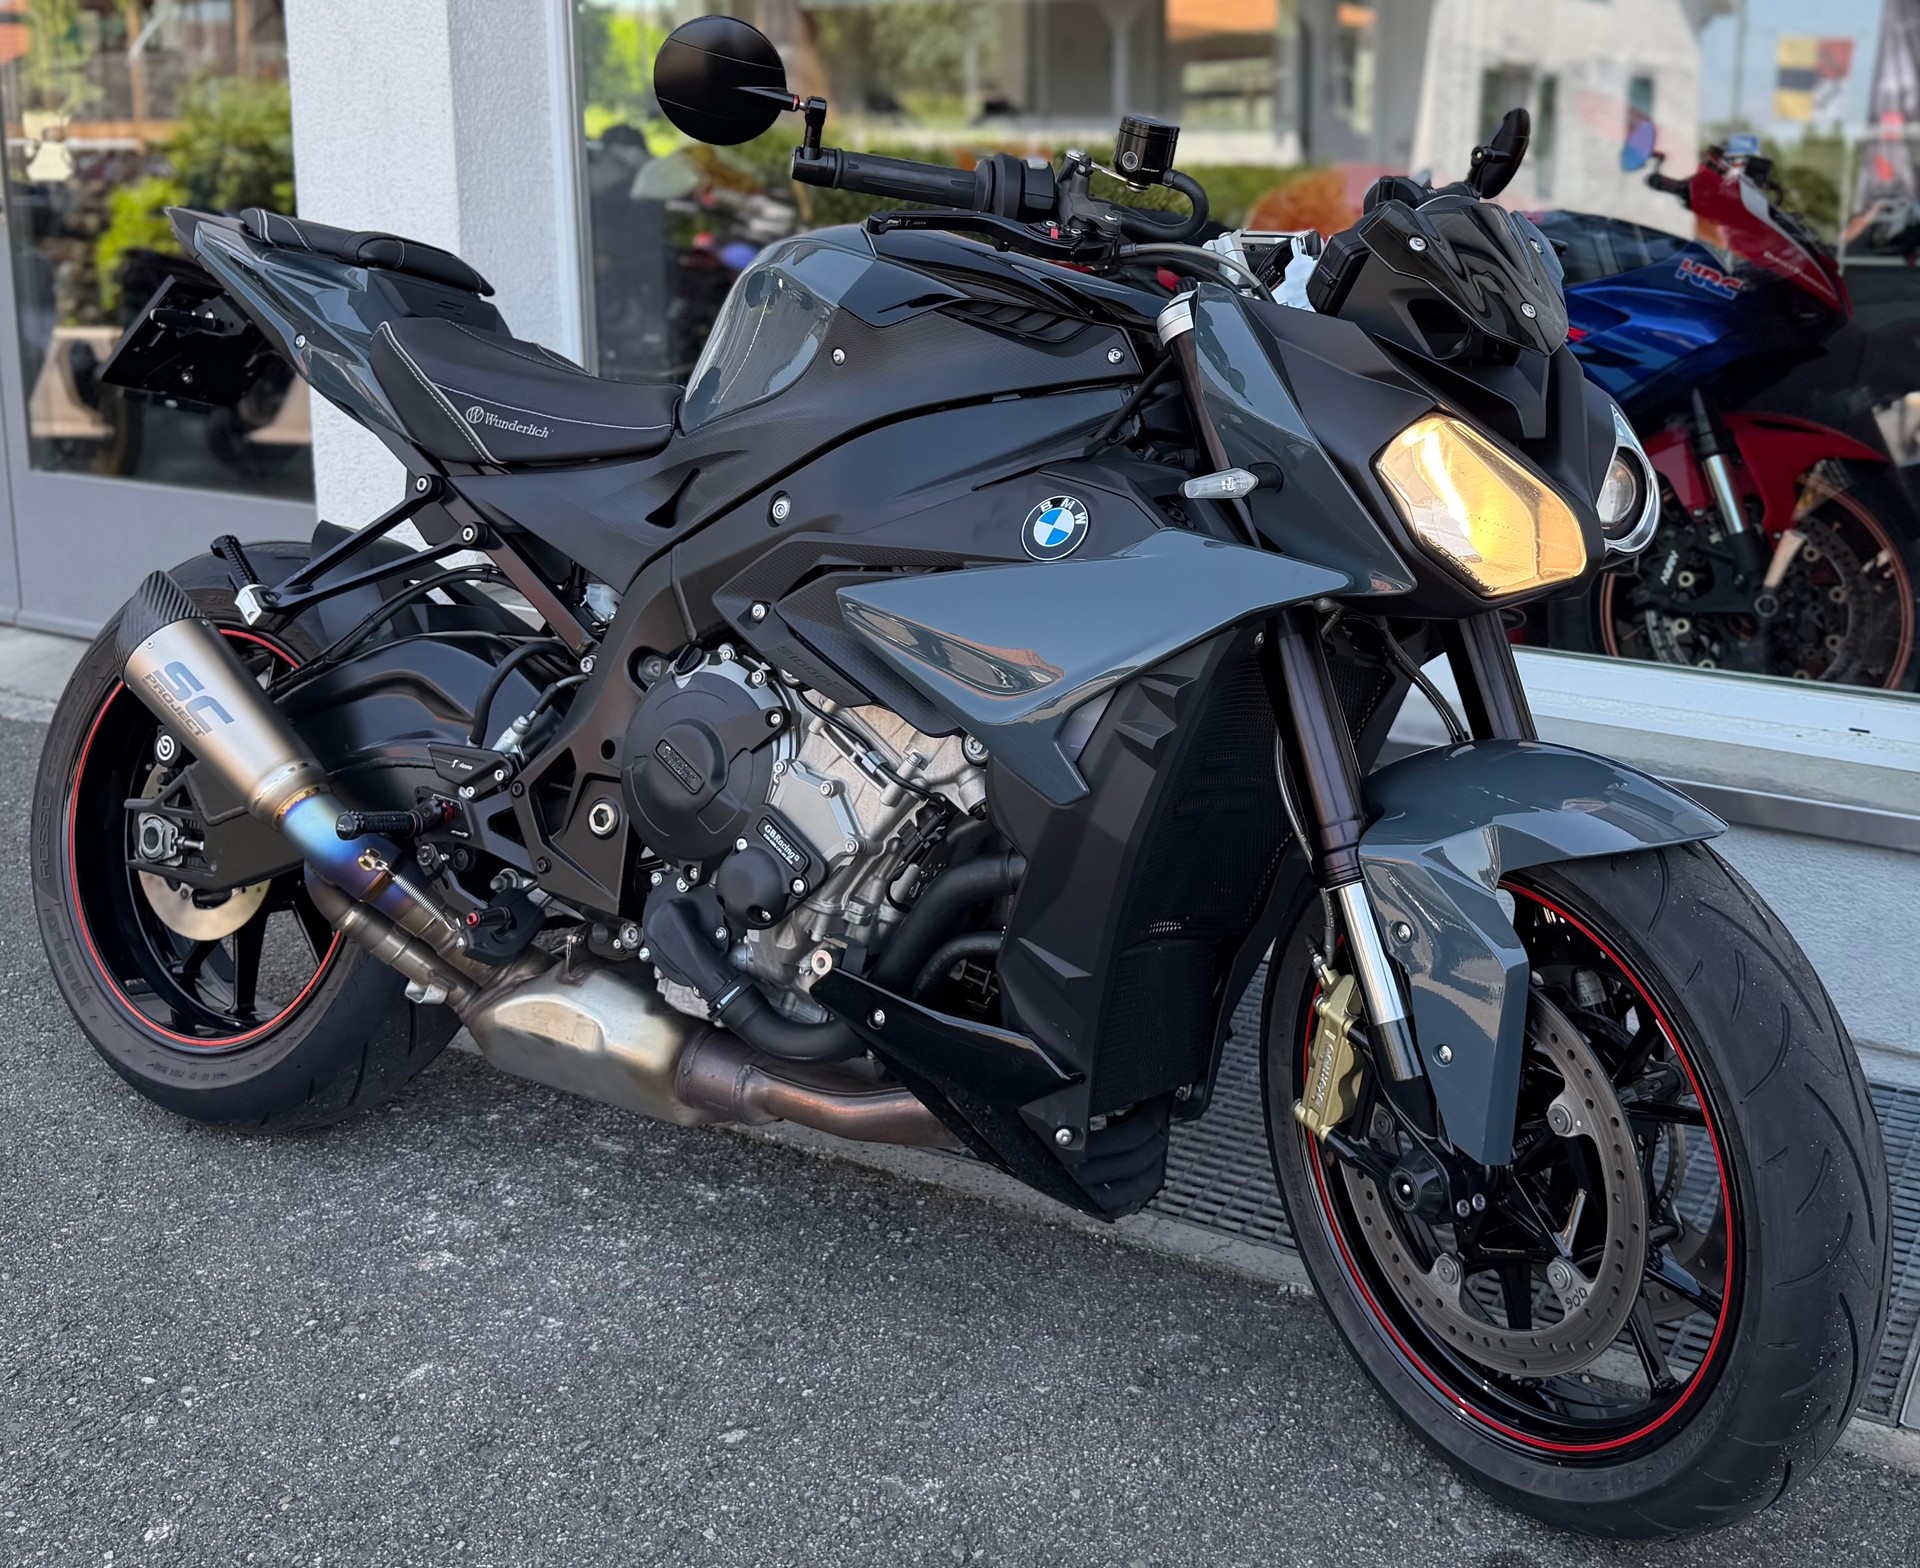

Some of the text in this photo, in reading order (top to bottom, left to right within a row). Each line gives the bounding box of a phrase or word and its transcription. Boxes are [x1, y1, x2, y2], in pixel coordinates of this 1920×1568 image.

[1674, 258, 1744, 300] HRC
[485, 412, 549, 438] Wunderlich
[1040, 497, 1087, 525] BMW
[144, 673, 206, 737] PROJECT
[152, 661, 235, 734] SC
[1312, 1043, 1335, 1108] brembo
